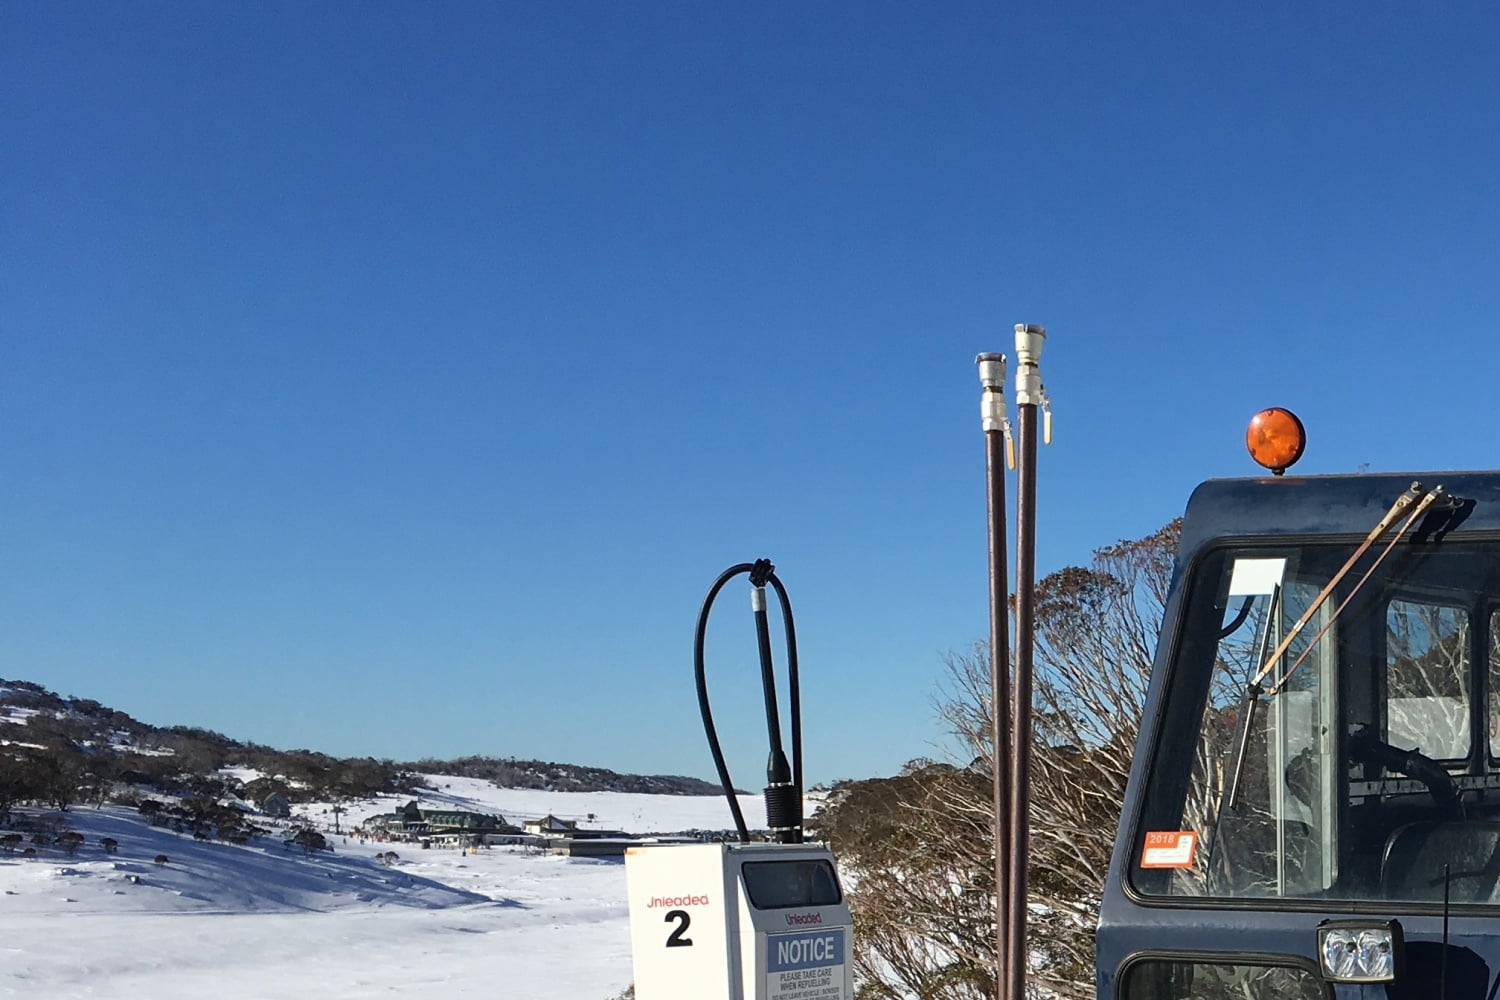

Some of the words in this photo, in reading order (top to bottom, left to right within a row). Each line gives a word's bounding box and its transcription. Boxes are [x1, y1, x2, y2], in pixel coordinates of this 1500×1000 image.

[1150, 834, 1174, 844] 2018
[785, 912, 822, 925] Unleaded
[664, 910, 693, 948] 2
[778, 936, 834, 965] NOTICE
[780, 970, 802, 982] PLEASE
[803, 970, 816, 978] TAKE
[817, 968, 832, 978] CARE
[780, 982, 796, 991] WHEN
[798, 978, 831, 989] REFUELLING
